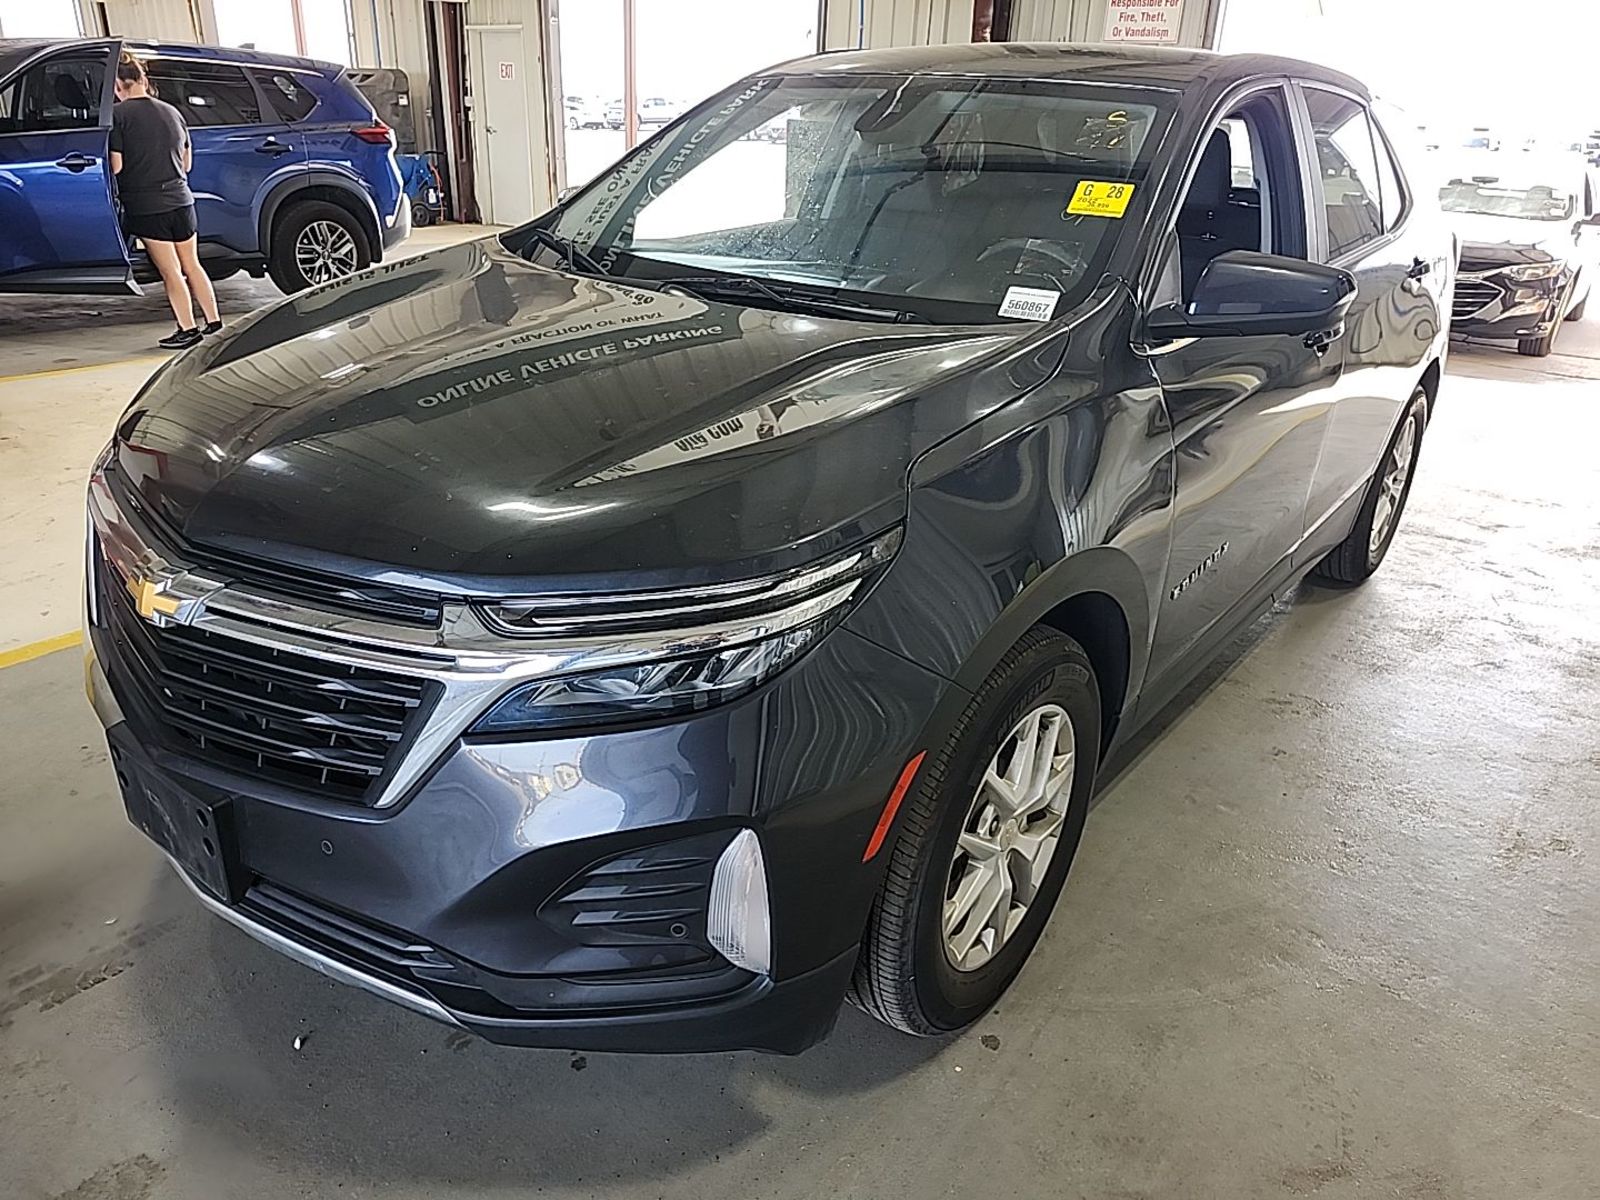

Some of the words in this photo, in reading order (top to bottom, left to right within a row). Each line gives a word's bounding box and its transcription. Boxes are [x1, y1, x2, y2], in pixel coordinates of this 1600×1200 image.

[1119, 12, 1137, 23] Fire,
[1141, 12, 1167, 23] Theft,
[1112, 27, 1121, 37] Or
[1125, 27, 1169, 38] Vandalism
[501, 64, 513, 79] EXIT
[1084, 184, 1094, 196] G
[1107, 186, 1125, 199] 28
[1007, 300, 1050, 313] 560867
[1170, 541, 1229, 600] EQUINOX
